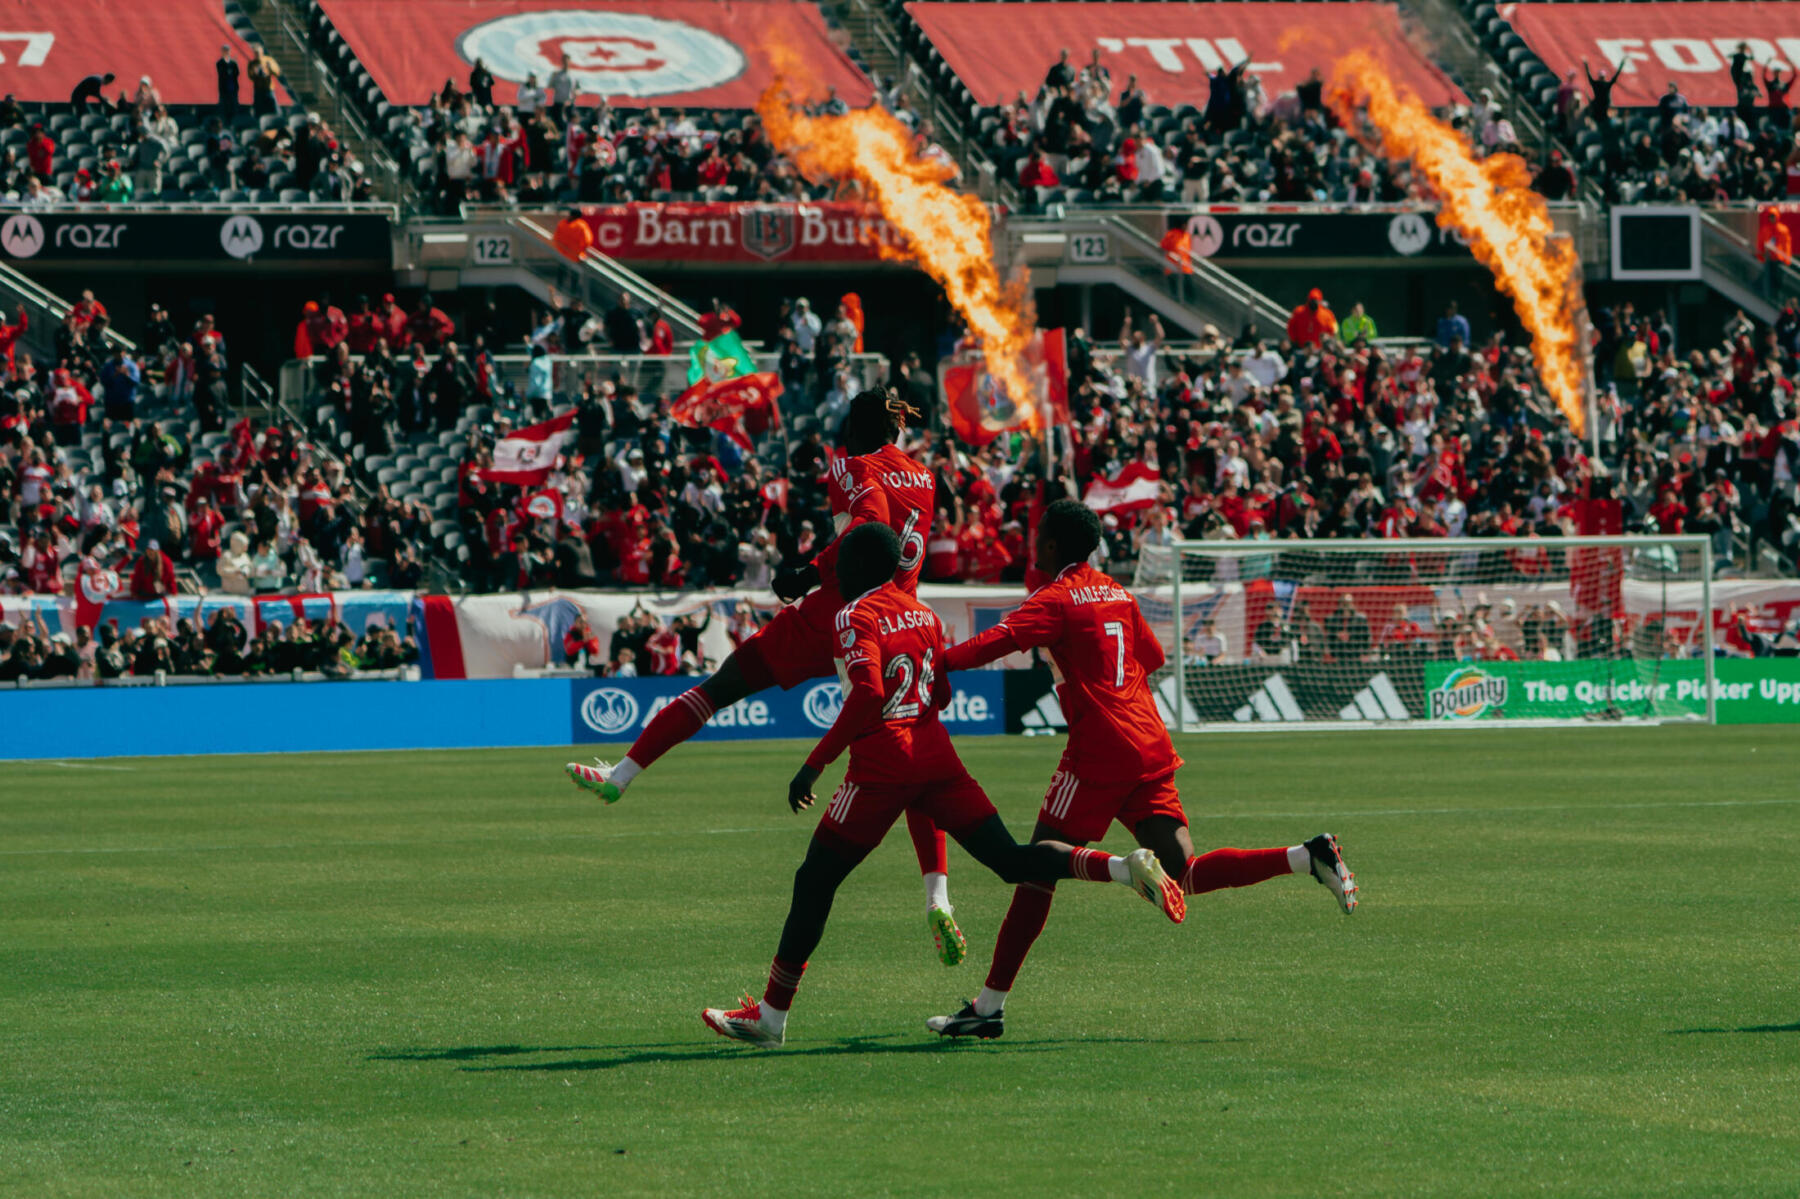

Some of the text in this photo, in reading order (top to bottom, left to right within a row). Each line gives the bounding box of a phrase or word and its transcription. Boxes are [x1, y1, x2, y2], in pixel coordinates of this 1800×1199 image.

[55, 225, 127, 248] razr
[274, 225, 344, 248] razr
[634, 207, 735, 246] Barn
[1233, 224, 1301, 247] razr
[476, 239, 510, 258] 122
[1073, 237, 1106, 257] 123
[898, 508, 924, 571] 6
[1103, 621, 1125, 688] 7
[1430, 677, 1507, 720] Bounty
[1523, 680, 1568, 702] The
